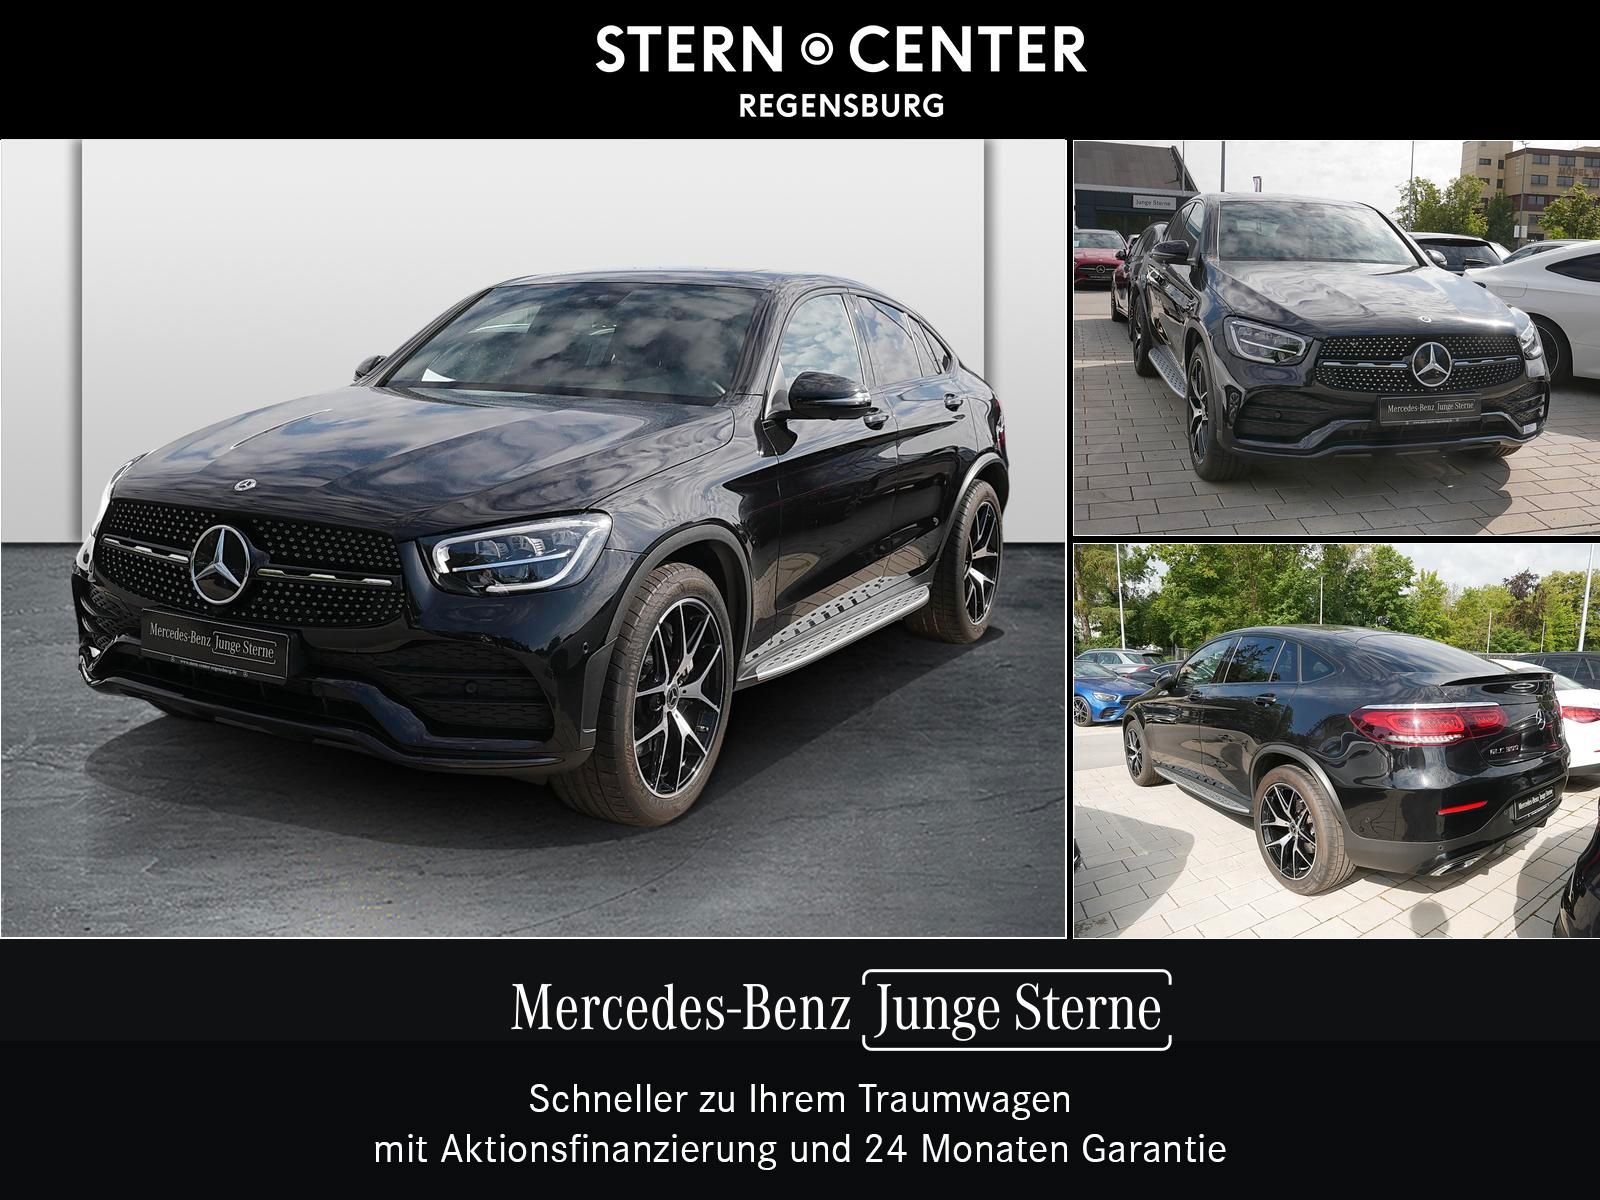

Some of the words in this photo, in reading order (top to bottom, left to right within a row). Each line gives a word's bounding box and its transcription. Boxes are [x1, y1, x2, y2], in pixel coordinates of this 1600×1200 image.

[1387, 404, 1435, 413] Mercedes-Benz
[1437, 402, 1454, 412] Junge
[1455, 402, 1474, 410] Sterne
[149, 622, 211, 647] Mercedes-Benz
[214, 635, 241, 654] Junge
[243, 641, 275, 659] Sterne
